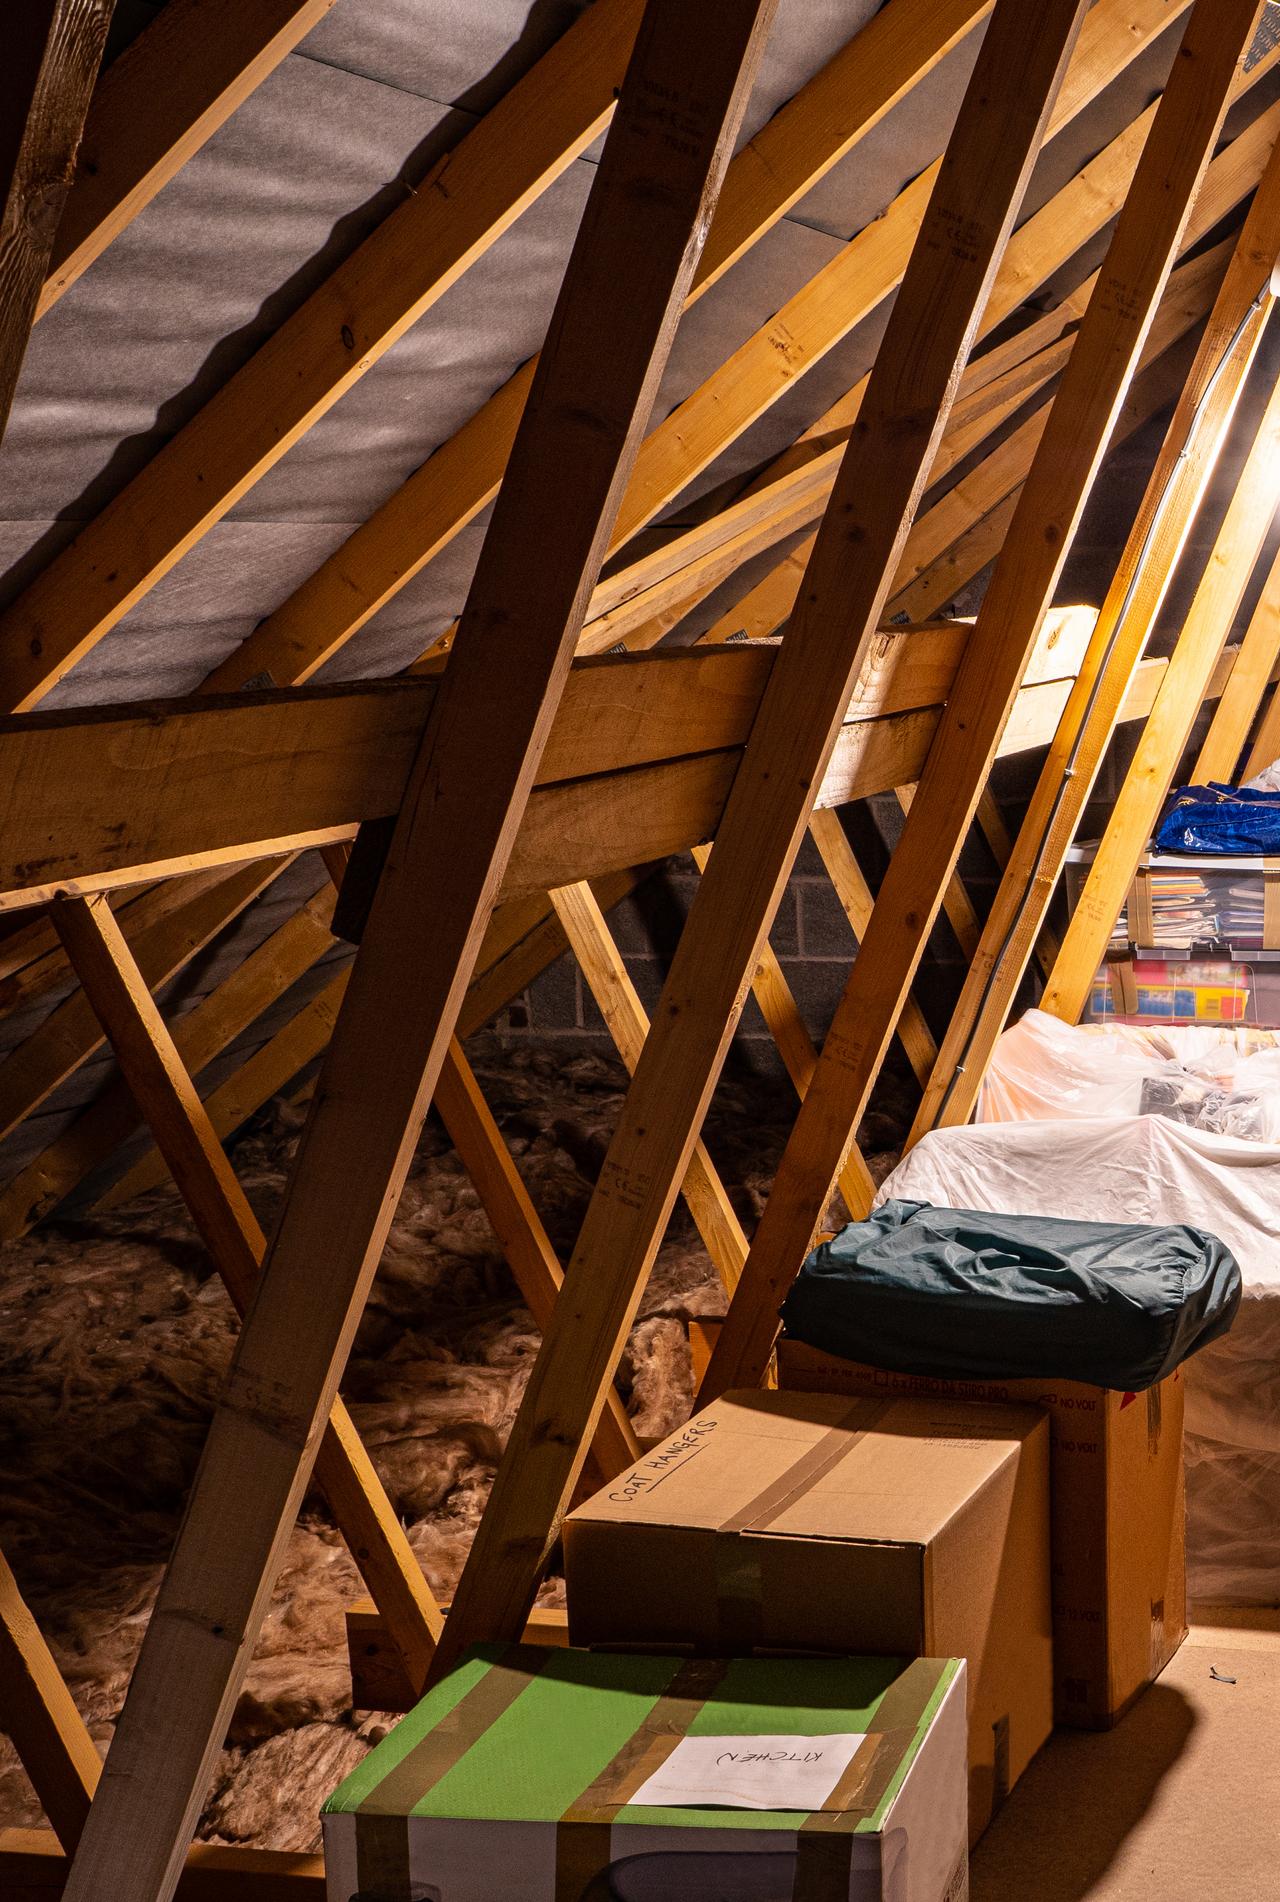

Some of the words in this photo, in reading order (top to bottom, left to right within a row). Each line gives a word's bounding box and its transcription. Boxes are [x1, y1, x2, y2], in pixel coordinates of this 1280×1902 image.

[942, 1379, 956, 1395] DA
[958, 1382, 985, 1398] STIRO
[988, 1385, 1009, 1401] PRO
[1060, 1398, 1074, 1409] NO
[1076, 1399, 1097, 1411] VOLT
[1062, 1440, 1075, 1452] NO
[1077, 1441, 1097, 1454] VOLT
[609, 1472, 652, 1502] COAT
[644, 1420, 718, 1470] HANGERS
[716, 1751, 823, 1766] KITCHEN
